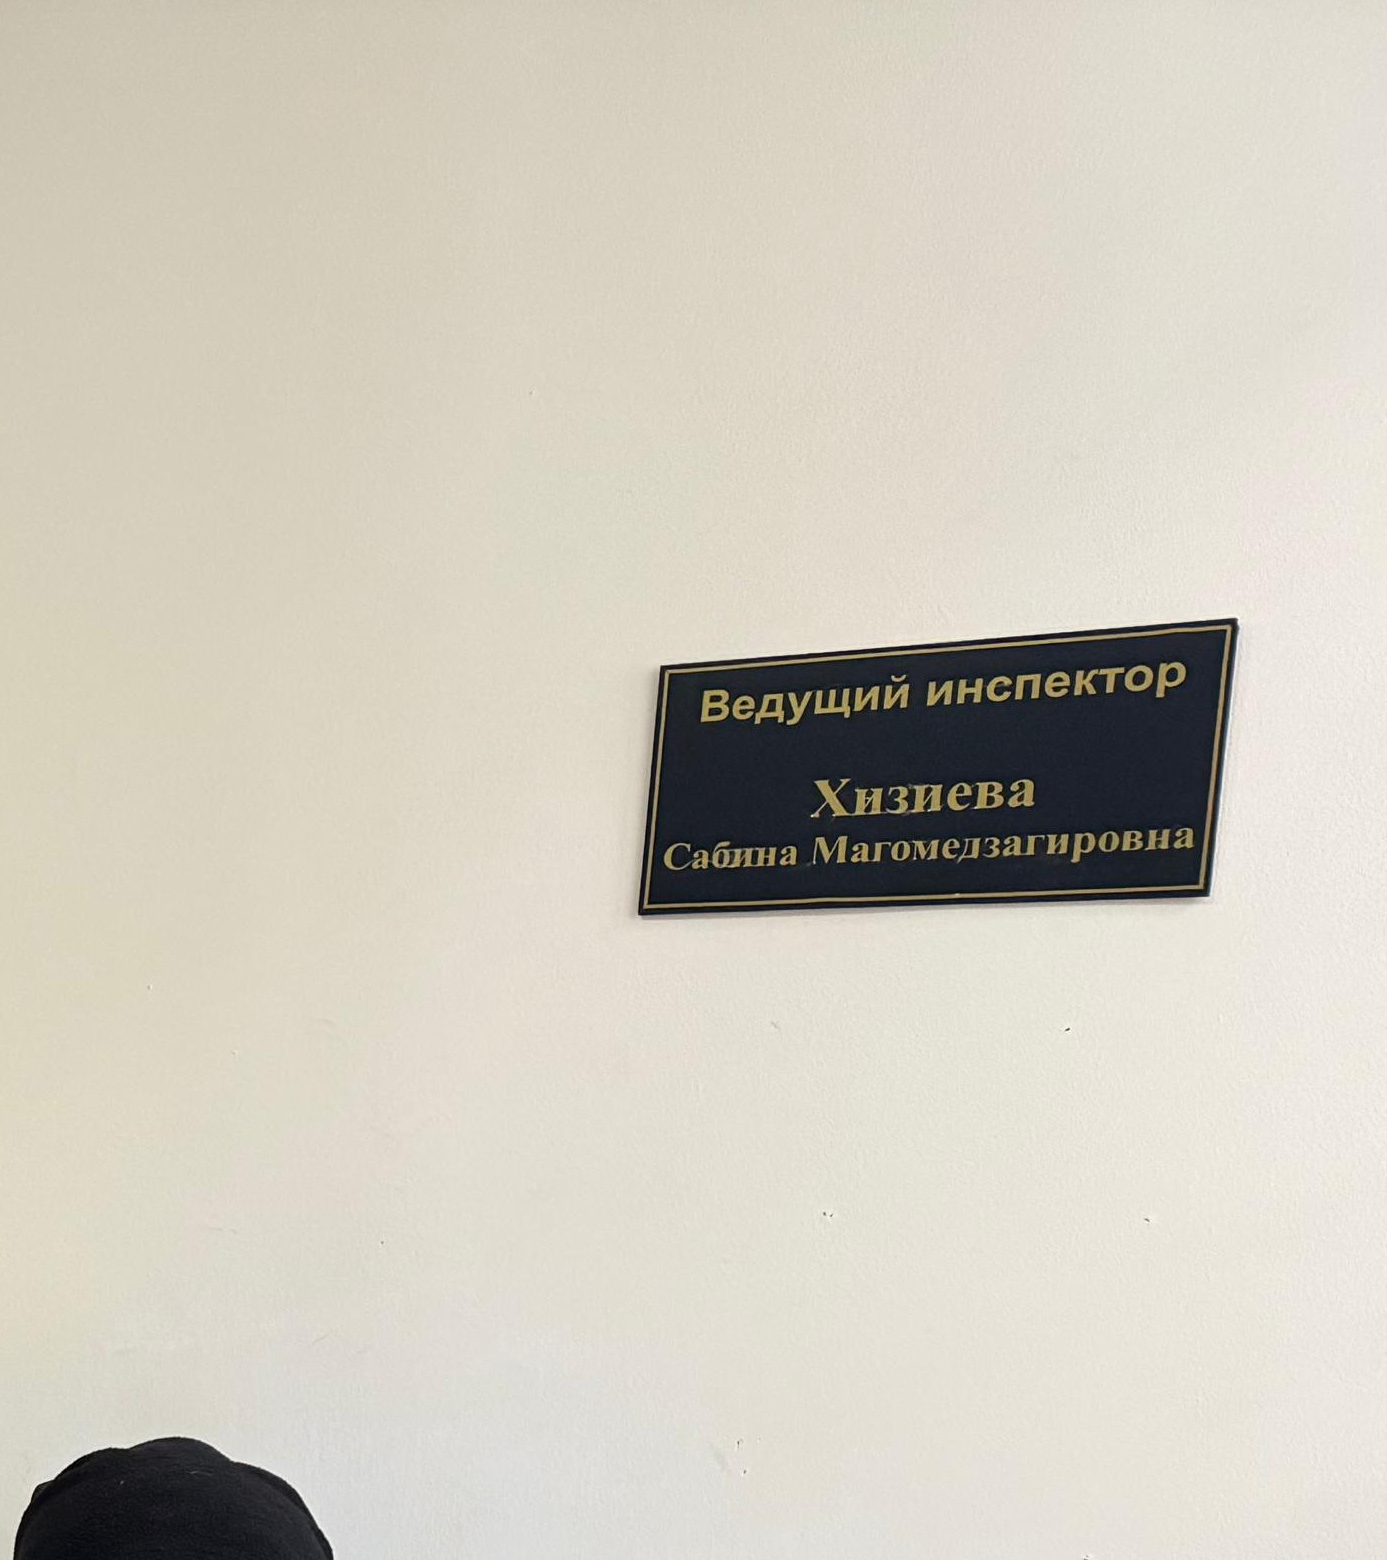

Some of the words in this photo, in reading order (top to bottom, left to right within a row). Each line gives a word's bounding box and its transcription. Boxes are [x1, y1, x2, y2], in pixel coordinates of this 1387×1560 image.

[699, 674, 909, 725] Ведущий
[927, 660, 1187, 706] инспектор
[810, 776, 1035, 818] Хизиева
[663, 840, 797, 871] Сабина
[812, 824, 1195, 866] Магомедзагировна
